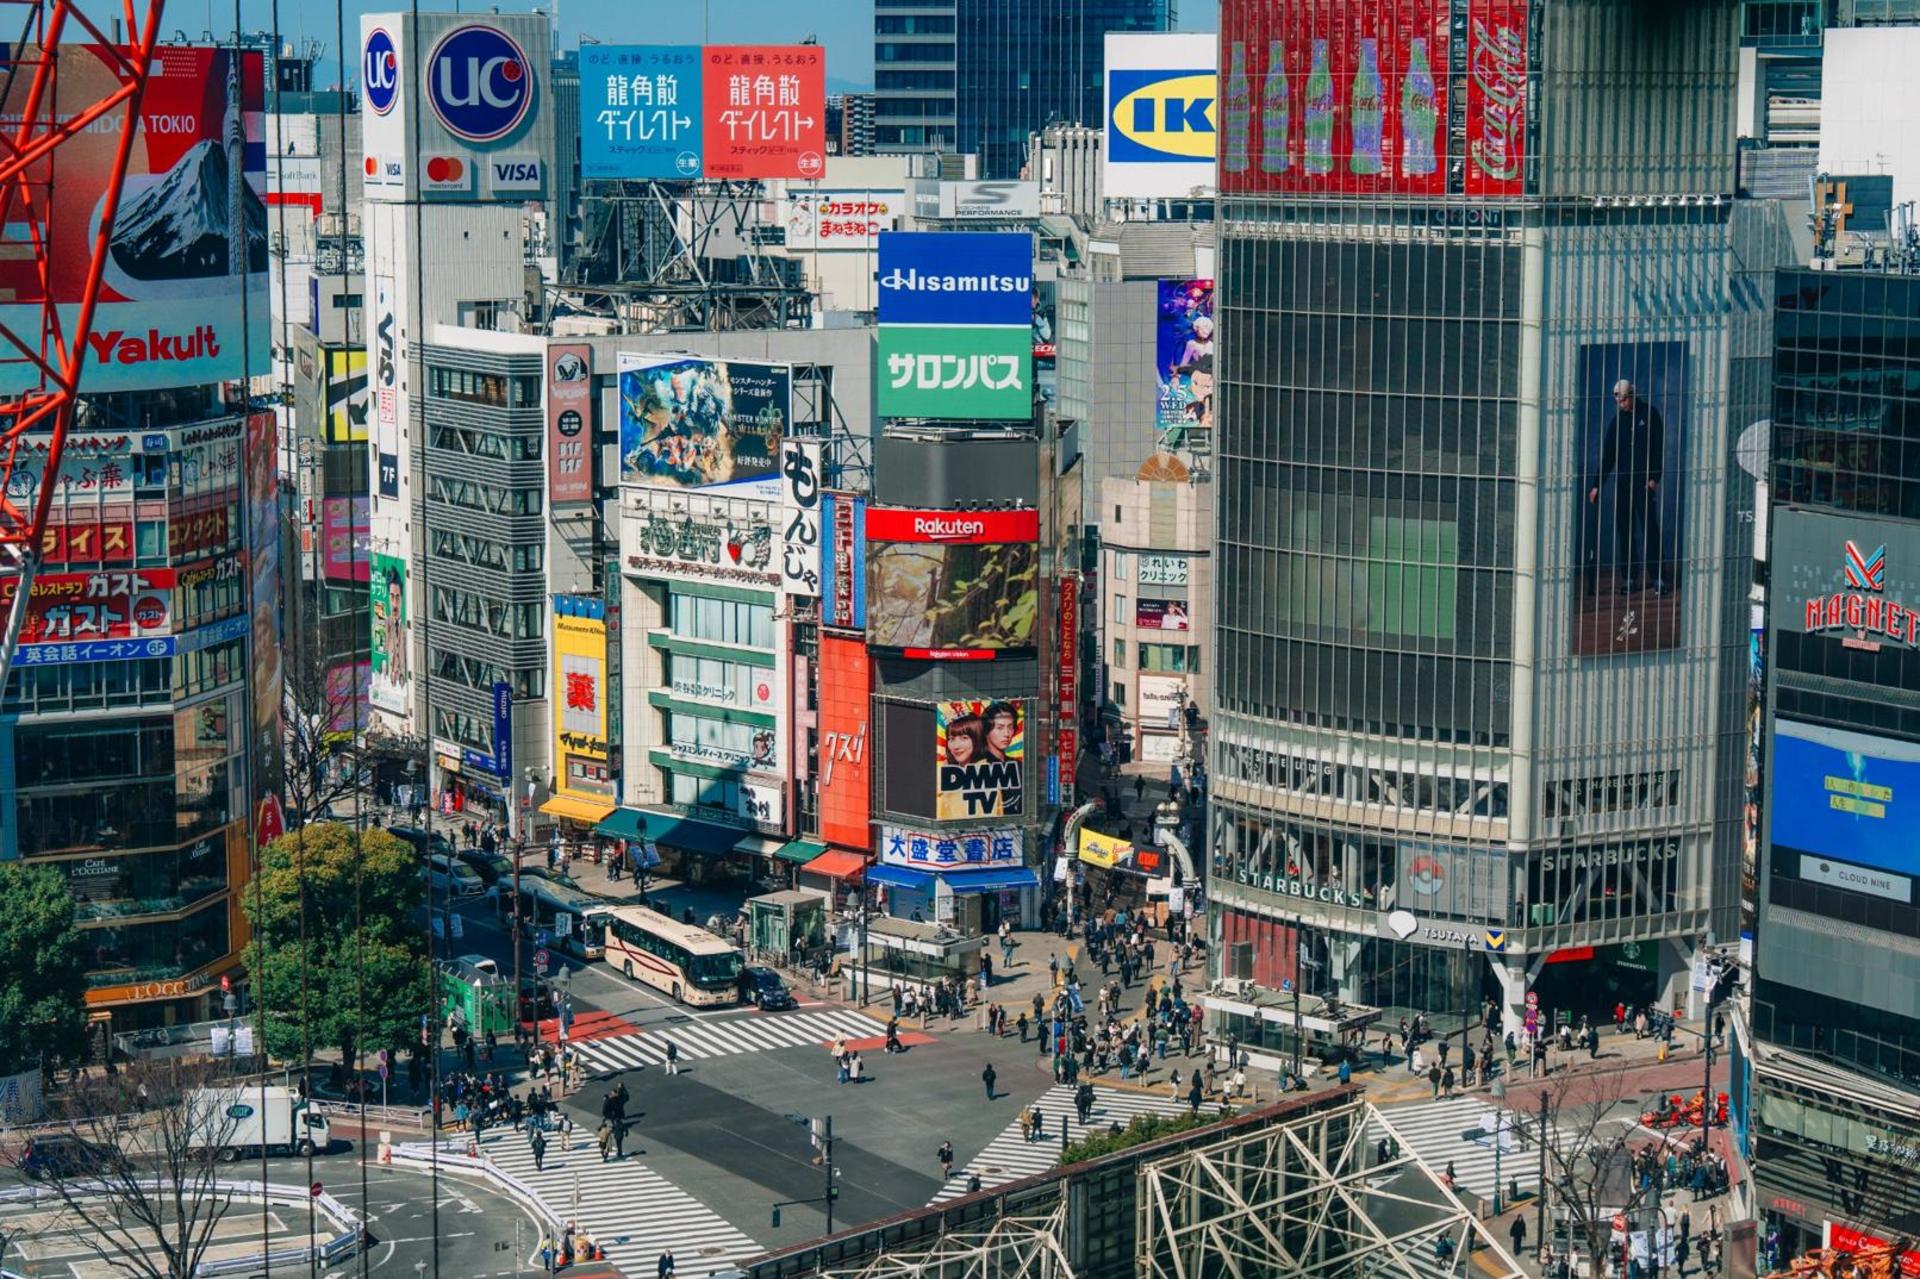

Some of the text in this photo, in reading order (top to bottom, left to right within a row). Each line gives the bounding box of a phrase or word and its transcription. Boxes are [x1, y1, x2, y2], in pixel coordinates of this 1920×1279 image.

[366, 50, 395, 89] UC
[440, 56, 520, 108] UC
[607, 74, 677, 106] 龍角散
[729, 74, 800, 106] 龍角散
[151, 115, 195, 134] TOKIO
[597, 110, 692, 141] ダイレクト
[720, 110, 814, 141] ダイレクト
[385, 163, 401, 176] VISA
[494, 164, 538, 181] VISA
[828, 202, 880, 216] カラオケ
[819, 220, 881, 238] まねきねこ
[881, 268, 1030, 292] Hisamitsu
[88, 325, 220, 365] Yakult
[888, 352, 1023, 390] サロンパス
[382, 466, 396, 483] 7F
[783, 441, 818, 593] もんじゃ
[914, 517, 984, 535] Rakuten
[1140, 570, 1187, 582] クリニック
[1151, 559, 1188, 569] れいわ
[88, 573, 150, 598] ガスト
[44, 604, 123, 638] ガスト
[1805, 592, 1920, 648] MAGNET
[26, 643, 141, 664] 英会話イーオン
[825, 720, 868, 786] クスリ
[940, 761, 1021, 792] DMM
[962, 789, 999, 816] TV
[889, 835, 1013, 863] 大盛堂書店
[1542, 843, 1678, 872] STARBUCKS
[1239, 868, 1362, 907] STARBUCKS
[1838, 871, 1892, 890] CLOUD NINE
[1423, 928, 1479, 945] TSUTAYA
